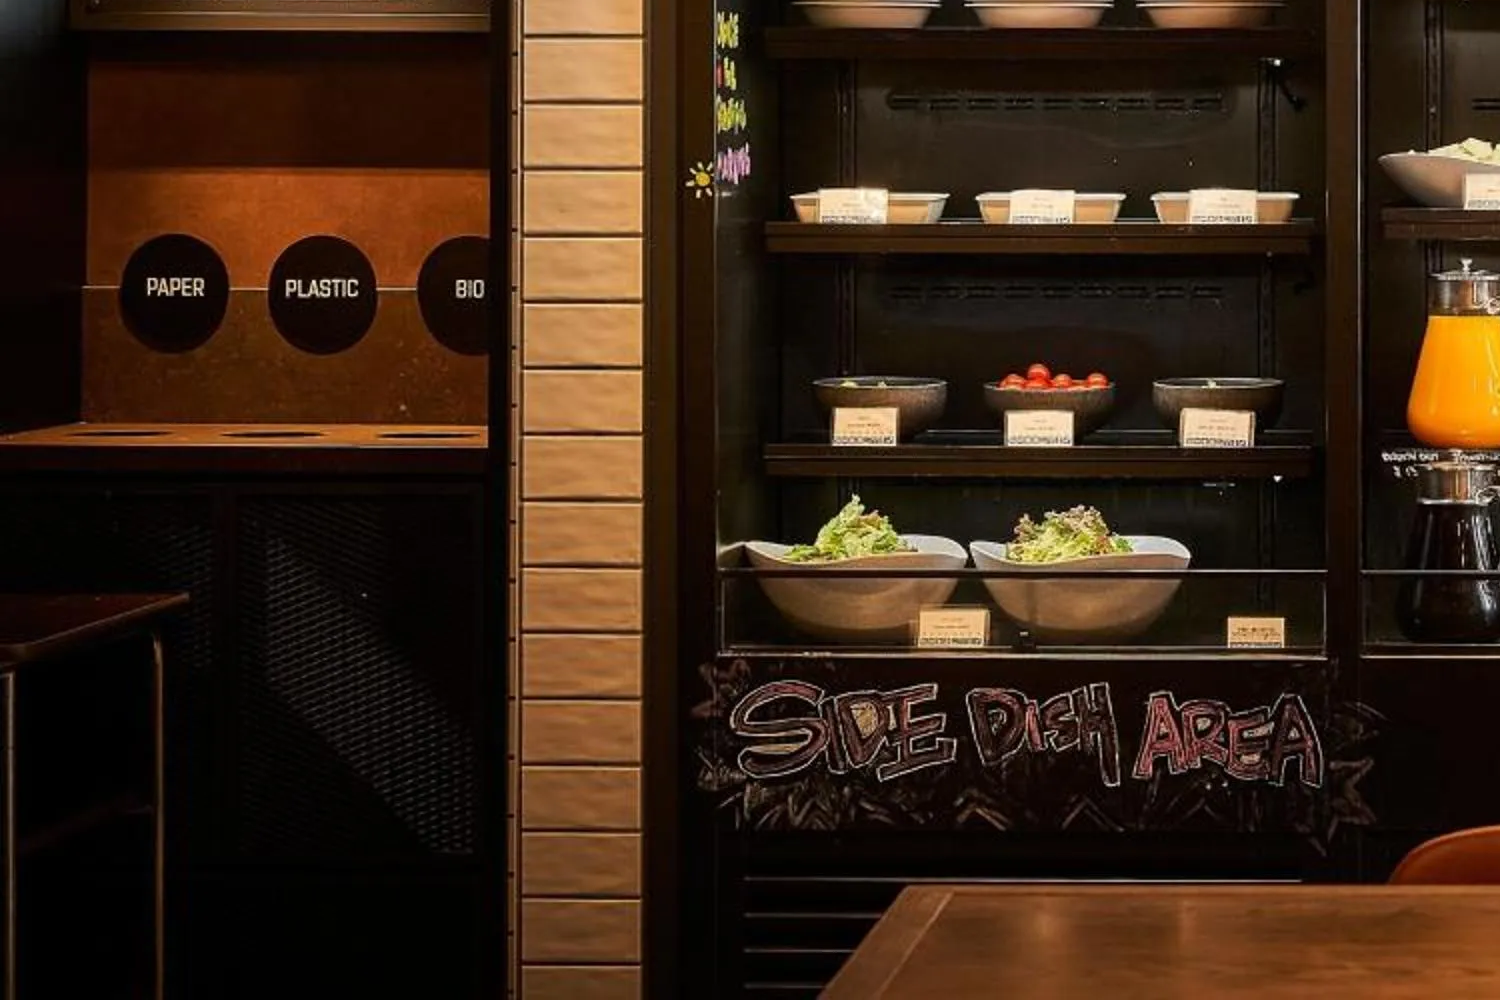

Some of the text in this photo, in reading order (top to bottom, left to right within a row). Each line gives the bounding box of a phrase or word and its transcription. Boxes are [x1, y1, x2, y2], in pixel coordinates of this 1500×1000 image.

[146, 277, 205, 297] PAPER
[284, 278, 360, 299] PLASTIC
[454, 279, 486, 299] BIO
[730, 679, 1324, 789] SIDE DISH AREA
